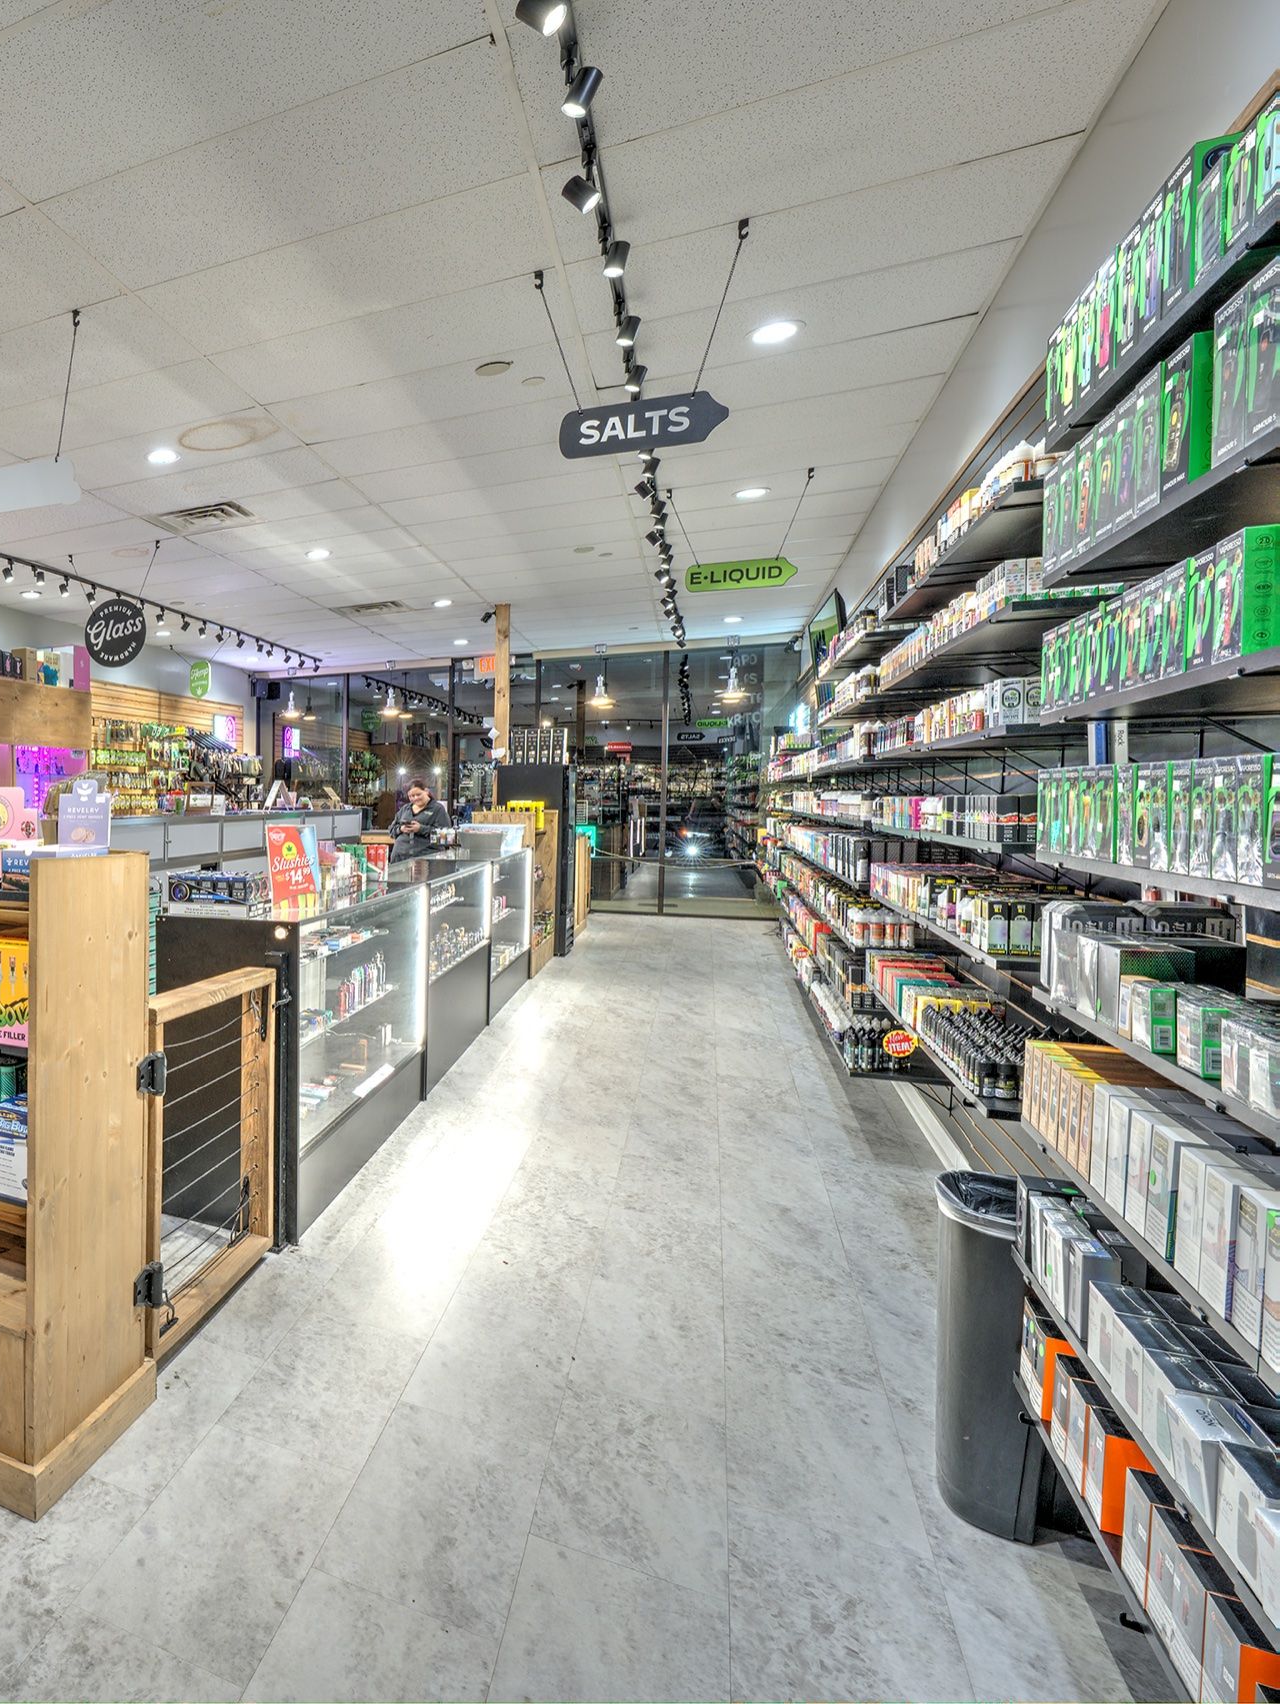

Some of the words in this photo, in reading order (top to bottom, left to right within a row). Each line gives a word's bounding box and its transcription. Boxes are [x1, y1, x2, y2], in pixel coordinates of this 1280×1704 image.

[1217, 294, 1244, 324] VAPORESSO
[1167, 345, 1191, 370] VAPORESSO
[578, 406, 691, 445] SALTS
[1252, 416, 1272, 434] ARMOUR
[1219, 538, 1242, 555] VAPORESSO
[1195, 553, 1214, 567] PORESSO
[100, 605, 132, 617] PREMIUM
[86, 617, 143, 651] Glass
[100, 641, 137, 661] HARDWARE
[479, 655, 496, 673] EXI
[271, 854, 315, 873] Slushies
[3, 1031, 26, 1041] FILLER
[889, 1033, 903, 1044] New
[888, 1041, 912, 1052] ITEM!
